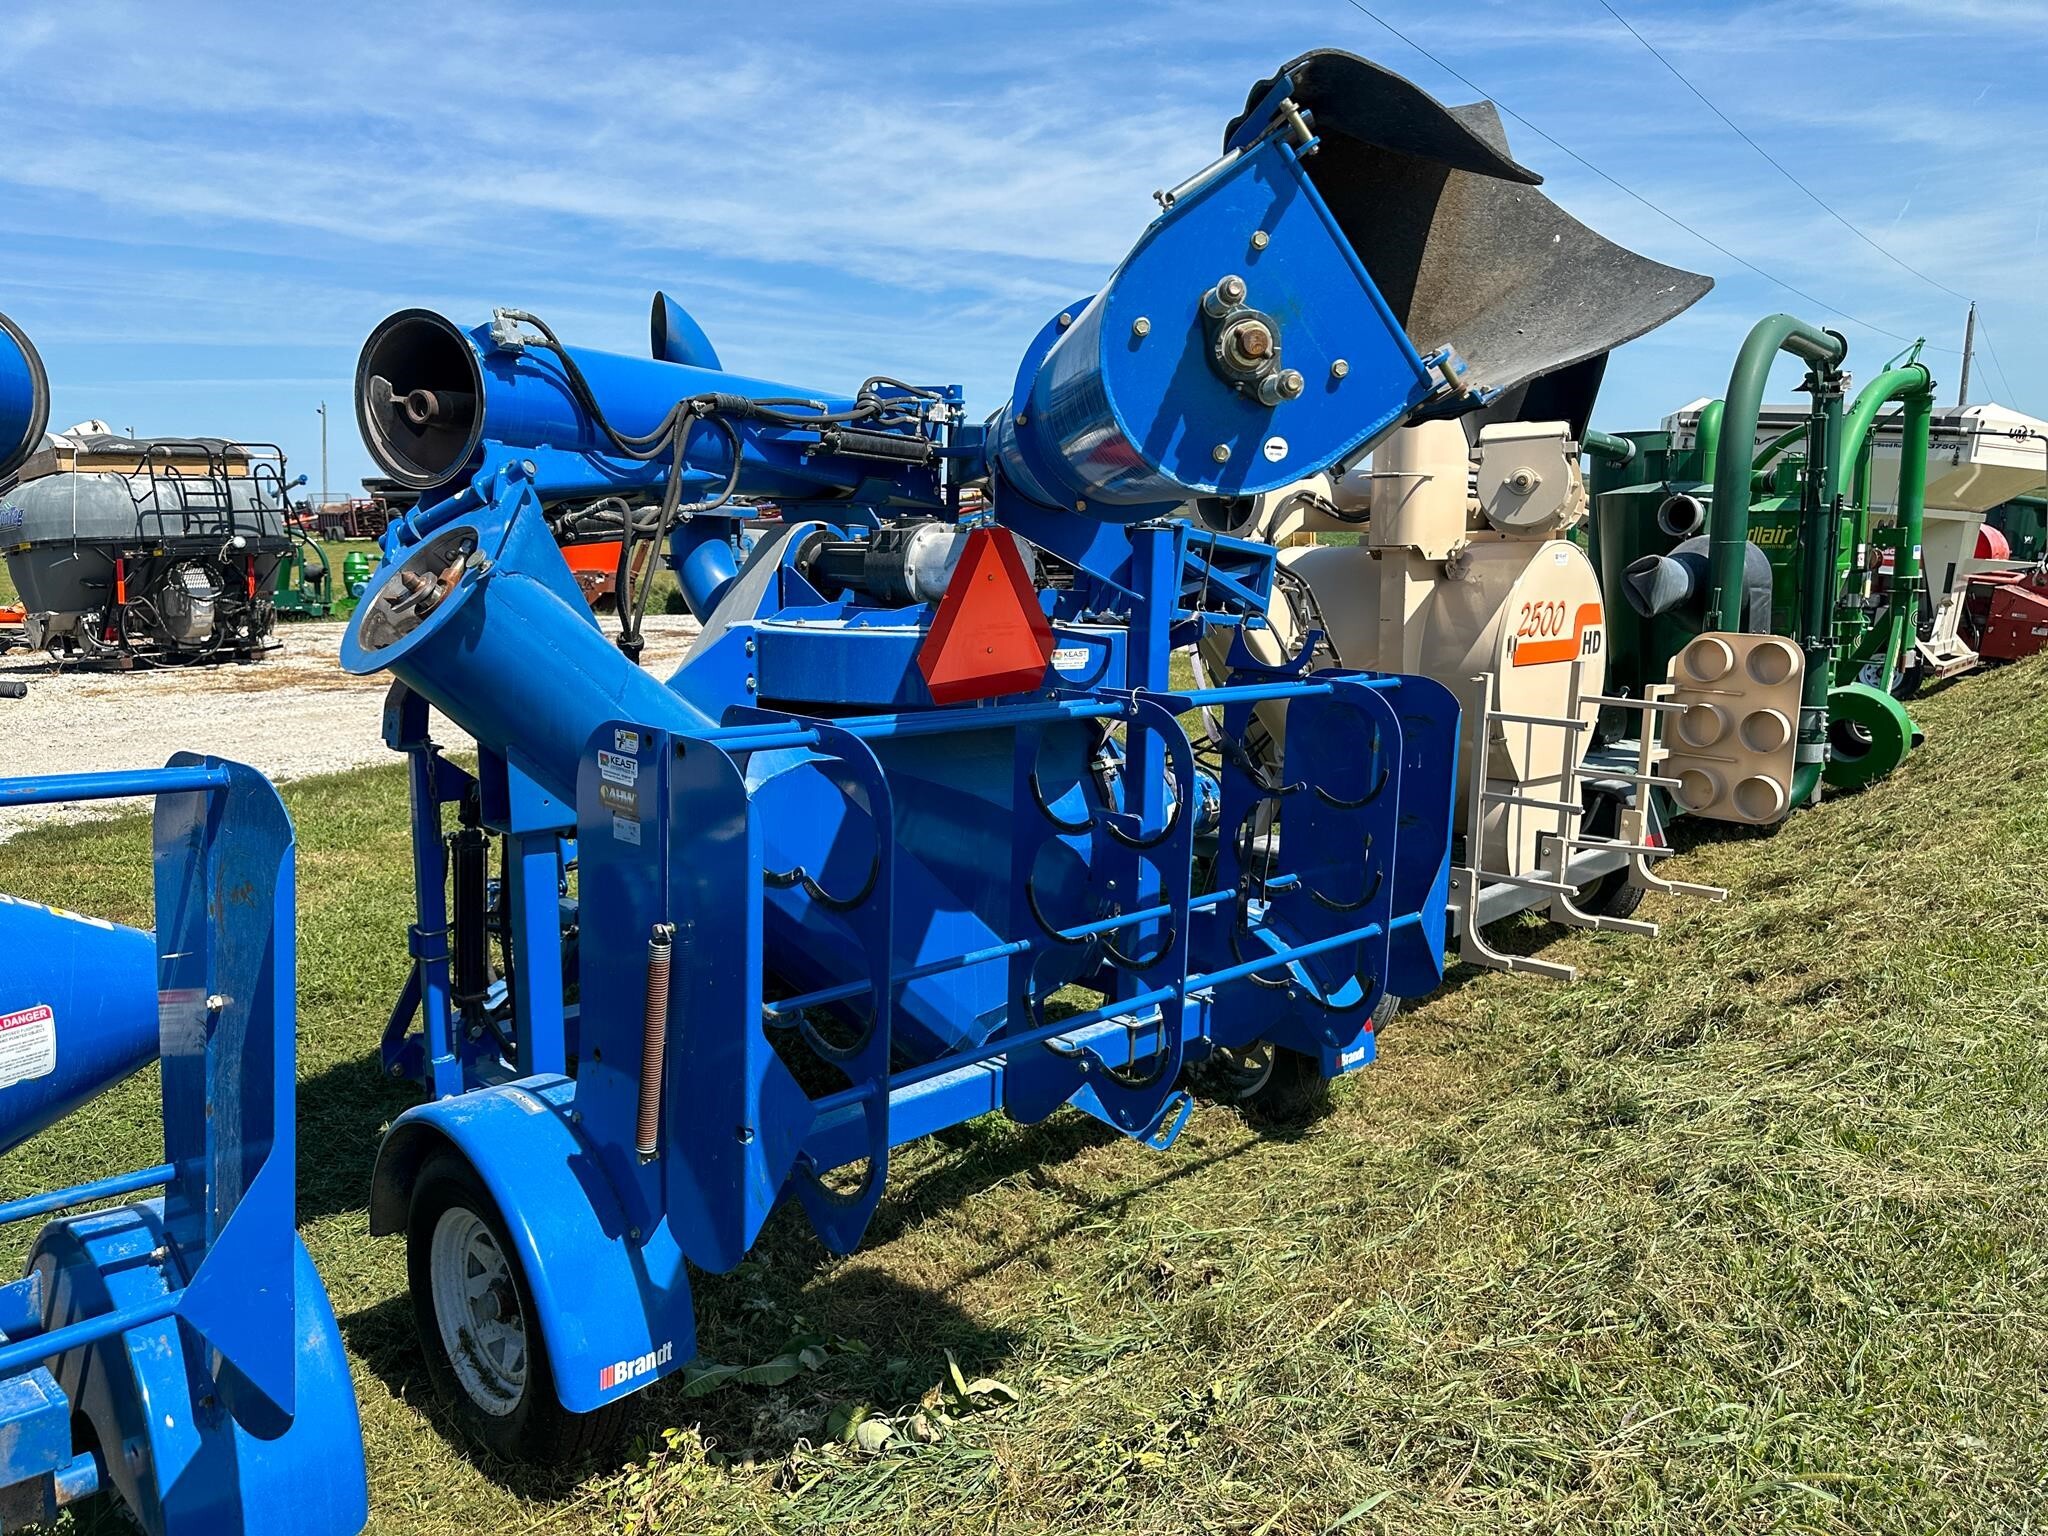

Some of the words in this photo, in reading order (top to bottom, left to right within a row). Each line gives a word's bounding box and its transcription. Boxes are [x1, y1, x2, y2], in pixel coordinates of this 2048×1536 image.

[1517, 600, 1566, 637] 2500
[1582, 630, 1601, 655] HD
[1063, 650, 1087, 658] KEAST
[610, 756, 636, 770] KEAST
[3, 1008, 47, 1028] DANGER
[614, 1341, 673, 1385] Brandt
